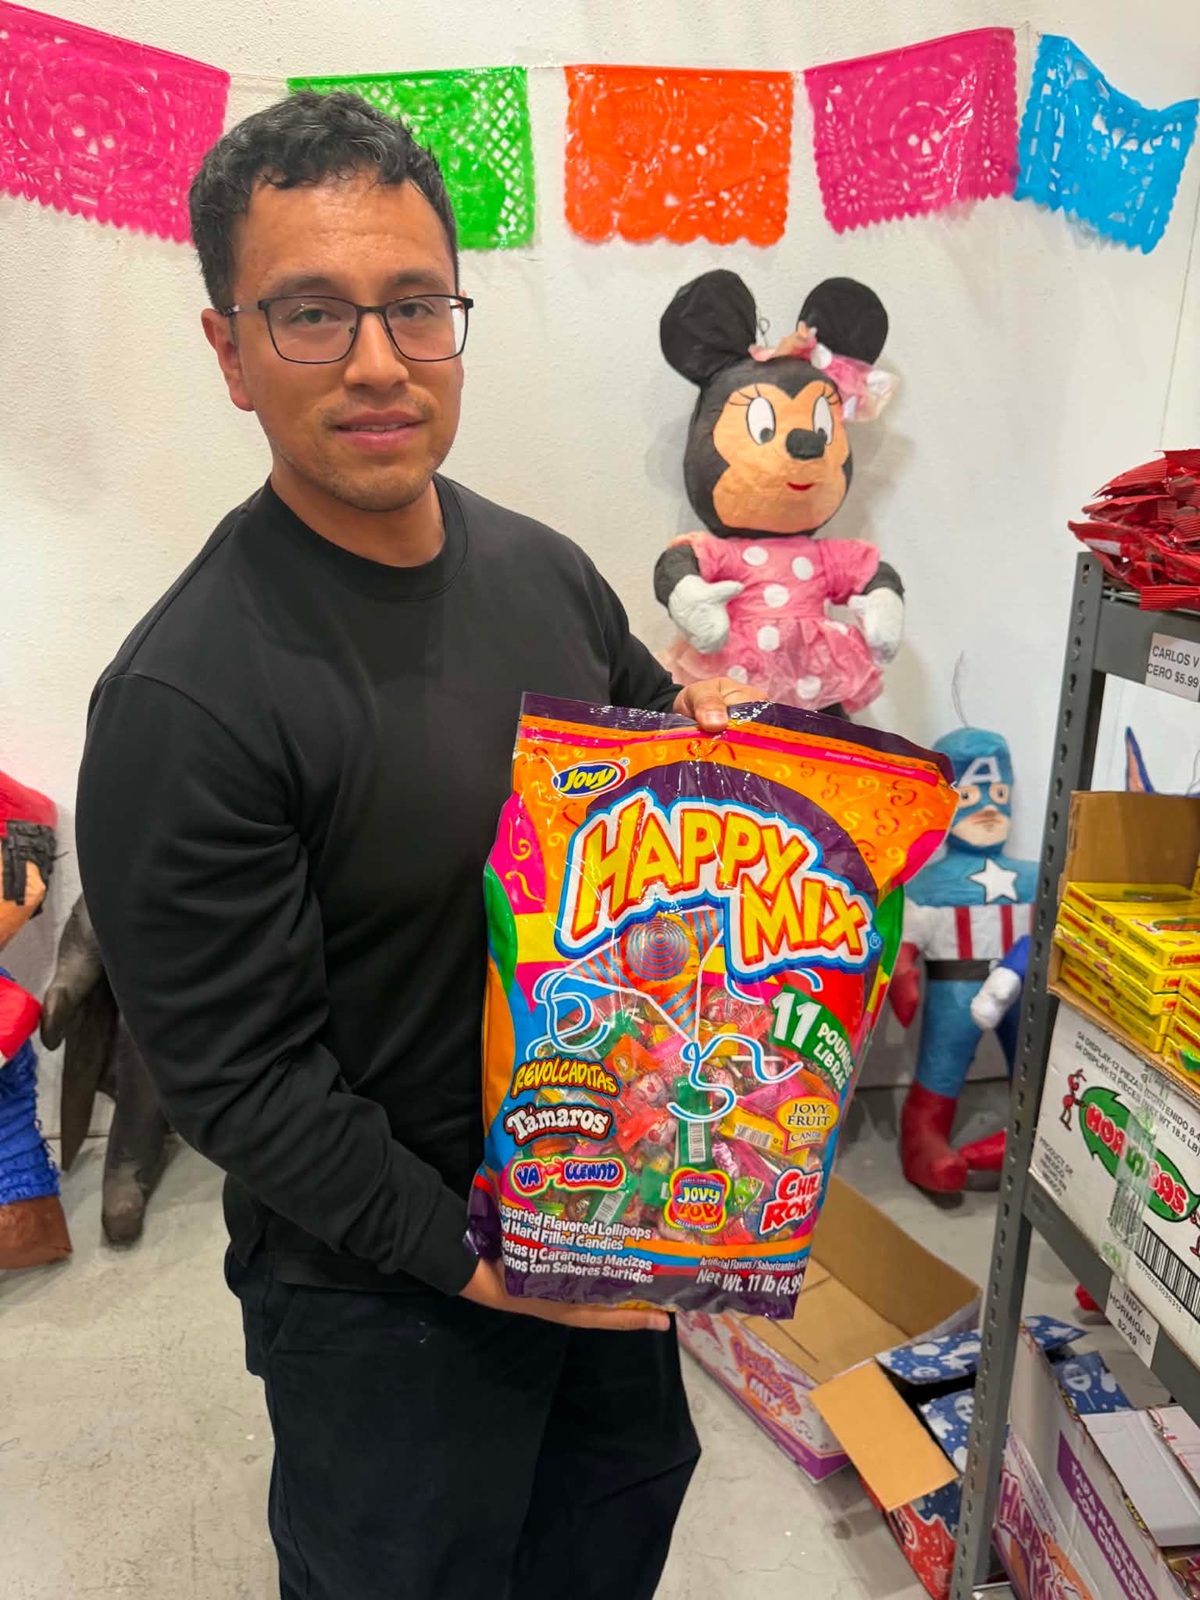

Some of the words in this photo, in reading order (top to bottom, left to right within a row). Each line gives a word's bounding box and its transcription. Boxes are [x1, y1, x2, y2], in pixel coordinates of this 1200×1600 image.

[1153, 645, 1190, 666] CARLOS
[1193, 655, 1199, 668] V
[1147, 663, 1172, 680] CERO
[1174, 671, 1199, 688] $5.99
[571, 798, 808, 940] HAPPY
[741, 873, 866, 966] MIX
[772, 991, 822, 1049] 11
[817, 1022, 853, 1078] POUNDS
[513, 1057, 618, 1096] REVOLCADITAS
[813, 1042, 846, 1089] LIBRAS
[787, 1115, 830, 1126] FRUIT
[793, 1103, 829, 1115] JOVY
[1172, 1126, 1186, 1143] 18.5
[1086, 1103, 1188, 1216] HORGAS
[516, 1165, 541, 1187] VA
[500, 1204, 543, 1227] ssorted
[543, 1215, 597, 1236] Flavored
[598, 1222, 652, 1240] Lollipops
[511, 1222, 541, 1242] Hard
[541, 1230, 575, 1246] Filled
[575, 1234, 624, 1250] Candies
[529, 1247, 538, 1264] y
[539, 1248, 602, 1265] Caramelos
[605, 1255, 653, 1271] Macizos
[700, 1257, 730, 1270] Artificial
[730, 1259, 752, 1270] Flavors
[529, 1263, 551, 1275] con
[552, 1262, 601, 1277] Sabores
[602, 1266, 654, 1284] Surtidos
[696, 1269, 721, 1286] Net
[722, 1274, 743, 1292] Wt.
[748, 1274, 761, 1292] 11
[762, 1274, 776, 1292] lb
[1110, 1292, 1151, 1345] HORMIGAS
